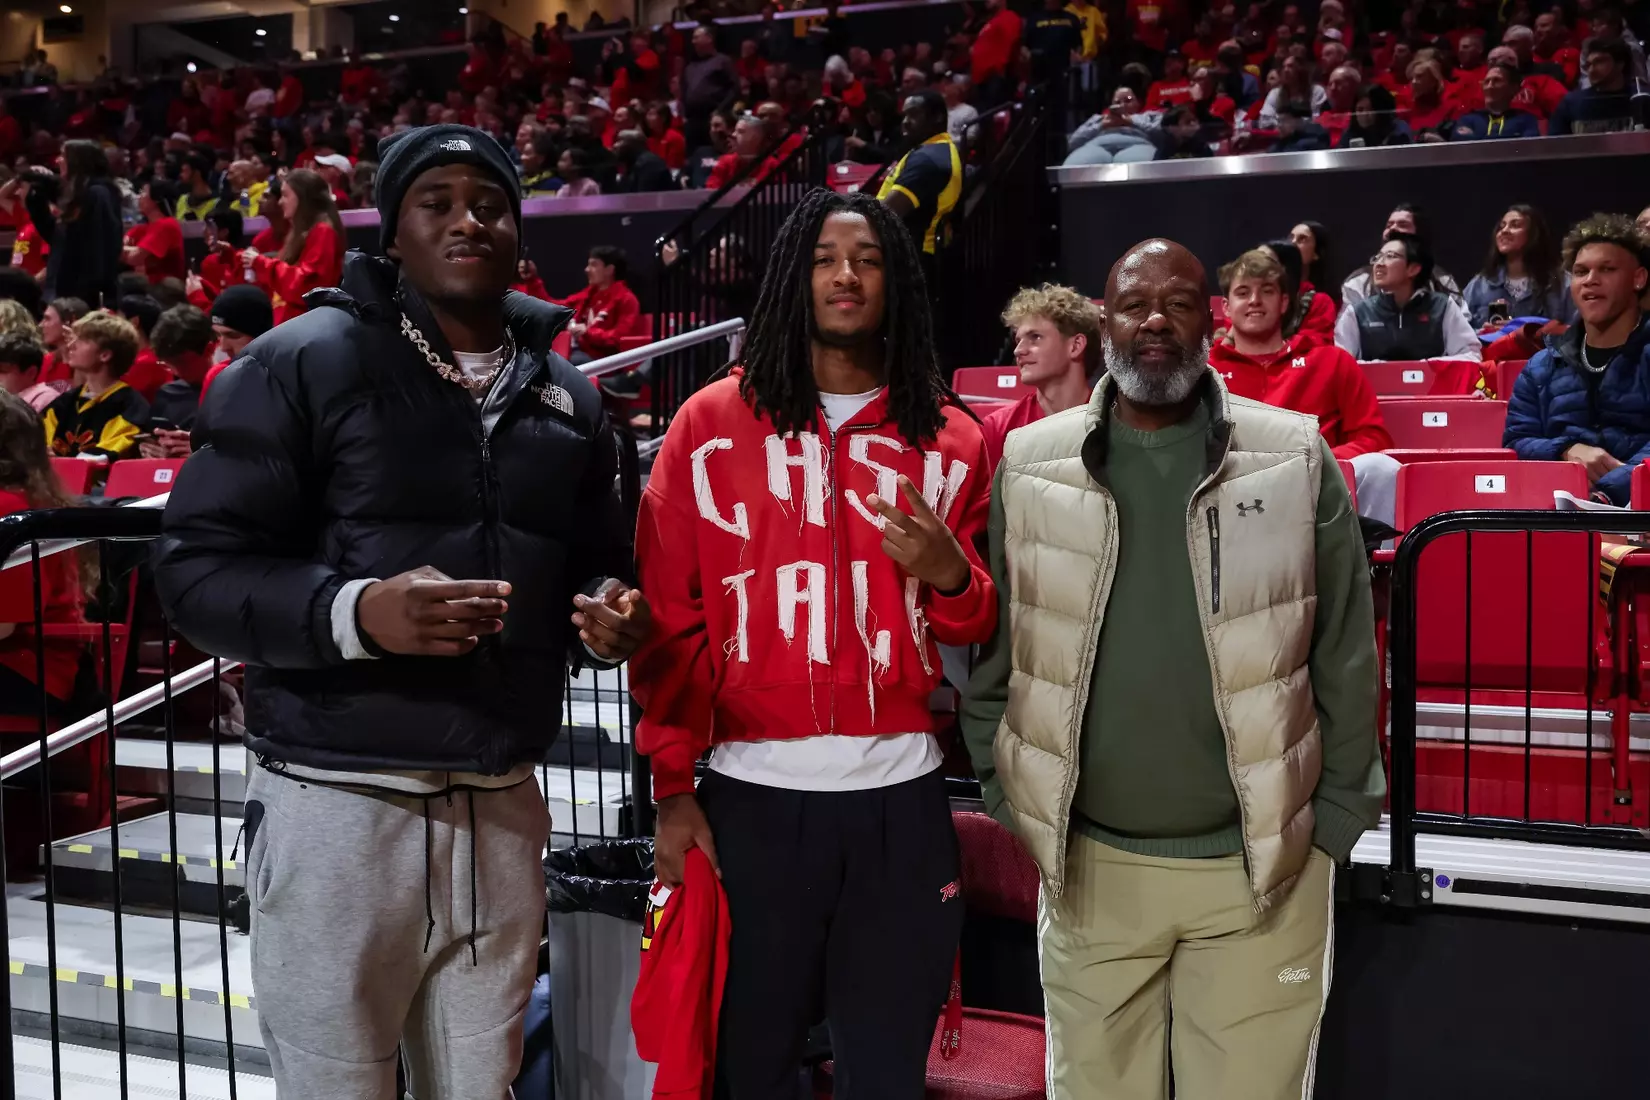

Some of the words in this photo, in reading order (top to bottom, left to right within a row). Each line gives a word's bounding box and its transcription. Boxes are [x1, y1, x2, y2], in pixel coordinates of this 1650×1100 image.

[1292, 357, 1305, 368] M
[545, 382, 561, 393] THE
[531, 385, 561, 402] NORTH
[541, 394, 561, 411] FACE
[1486, 479, 1494, 488] 4
